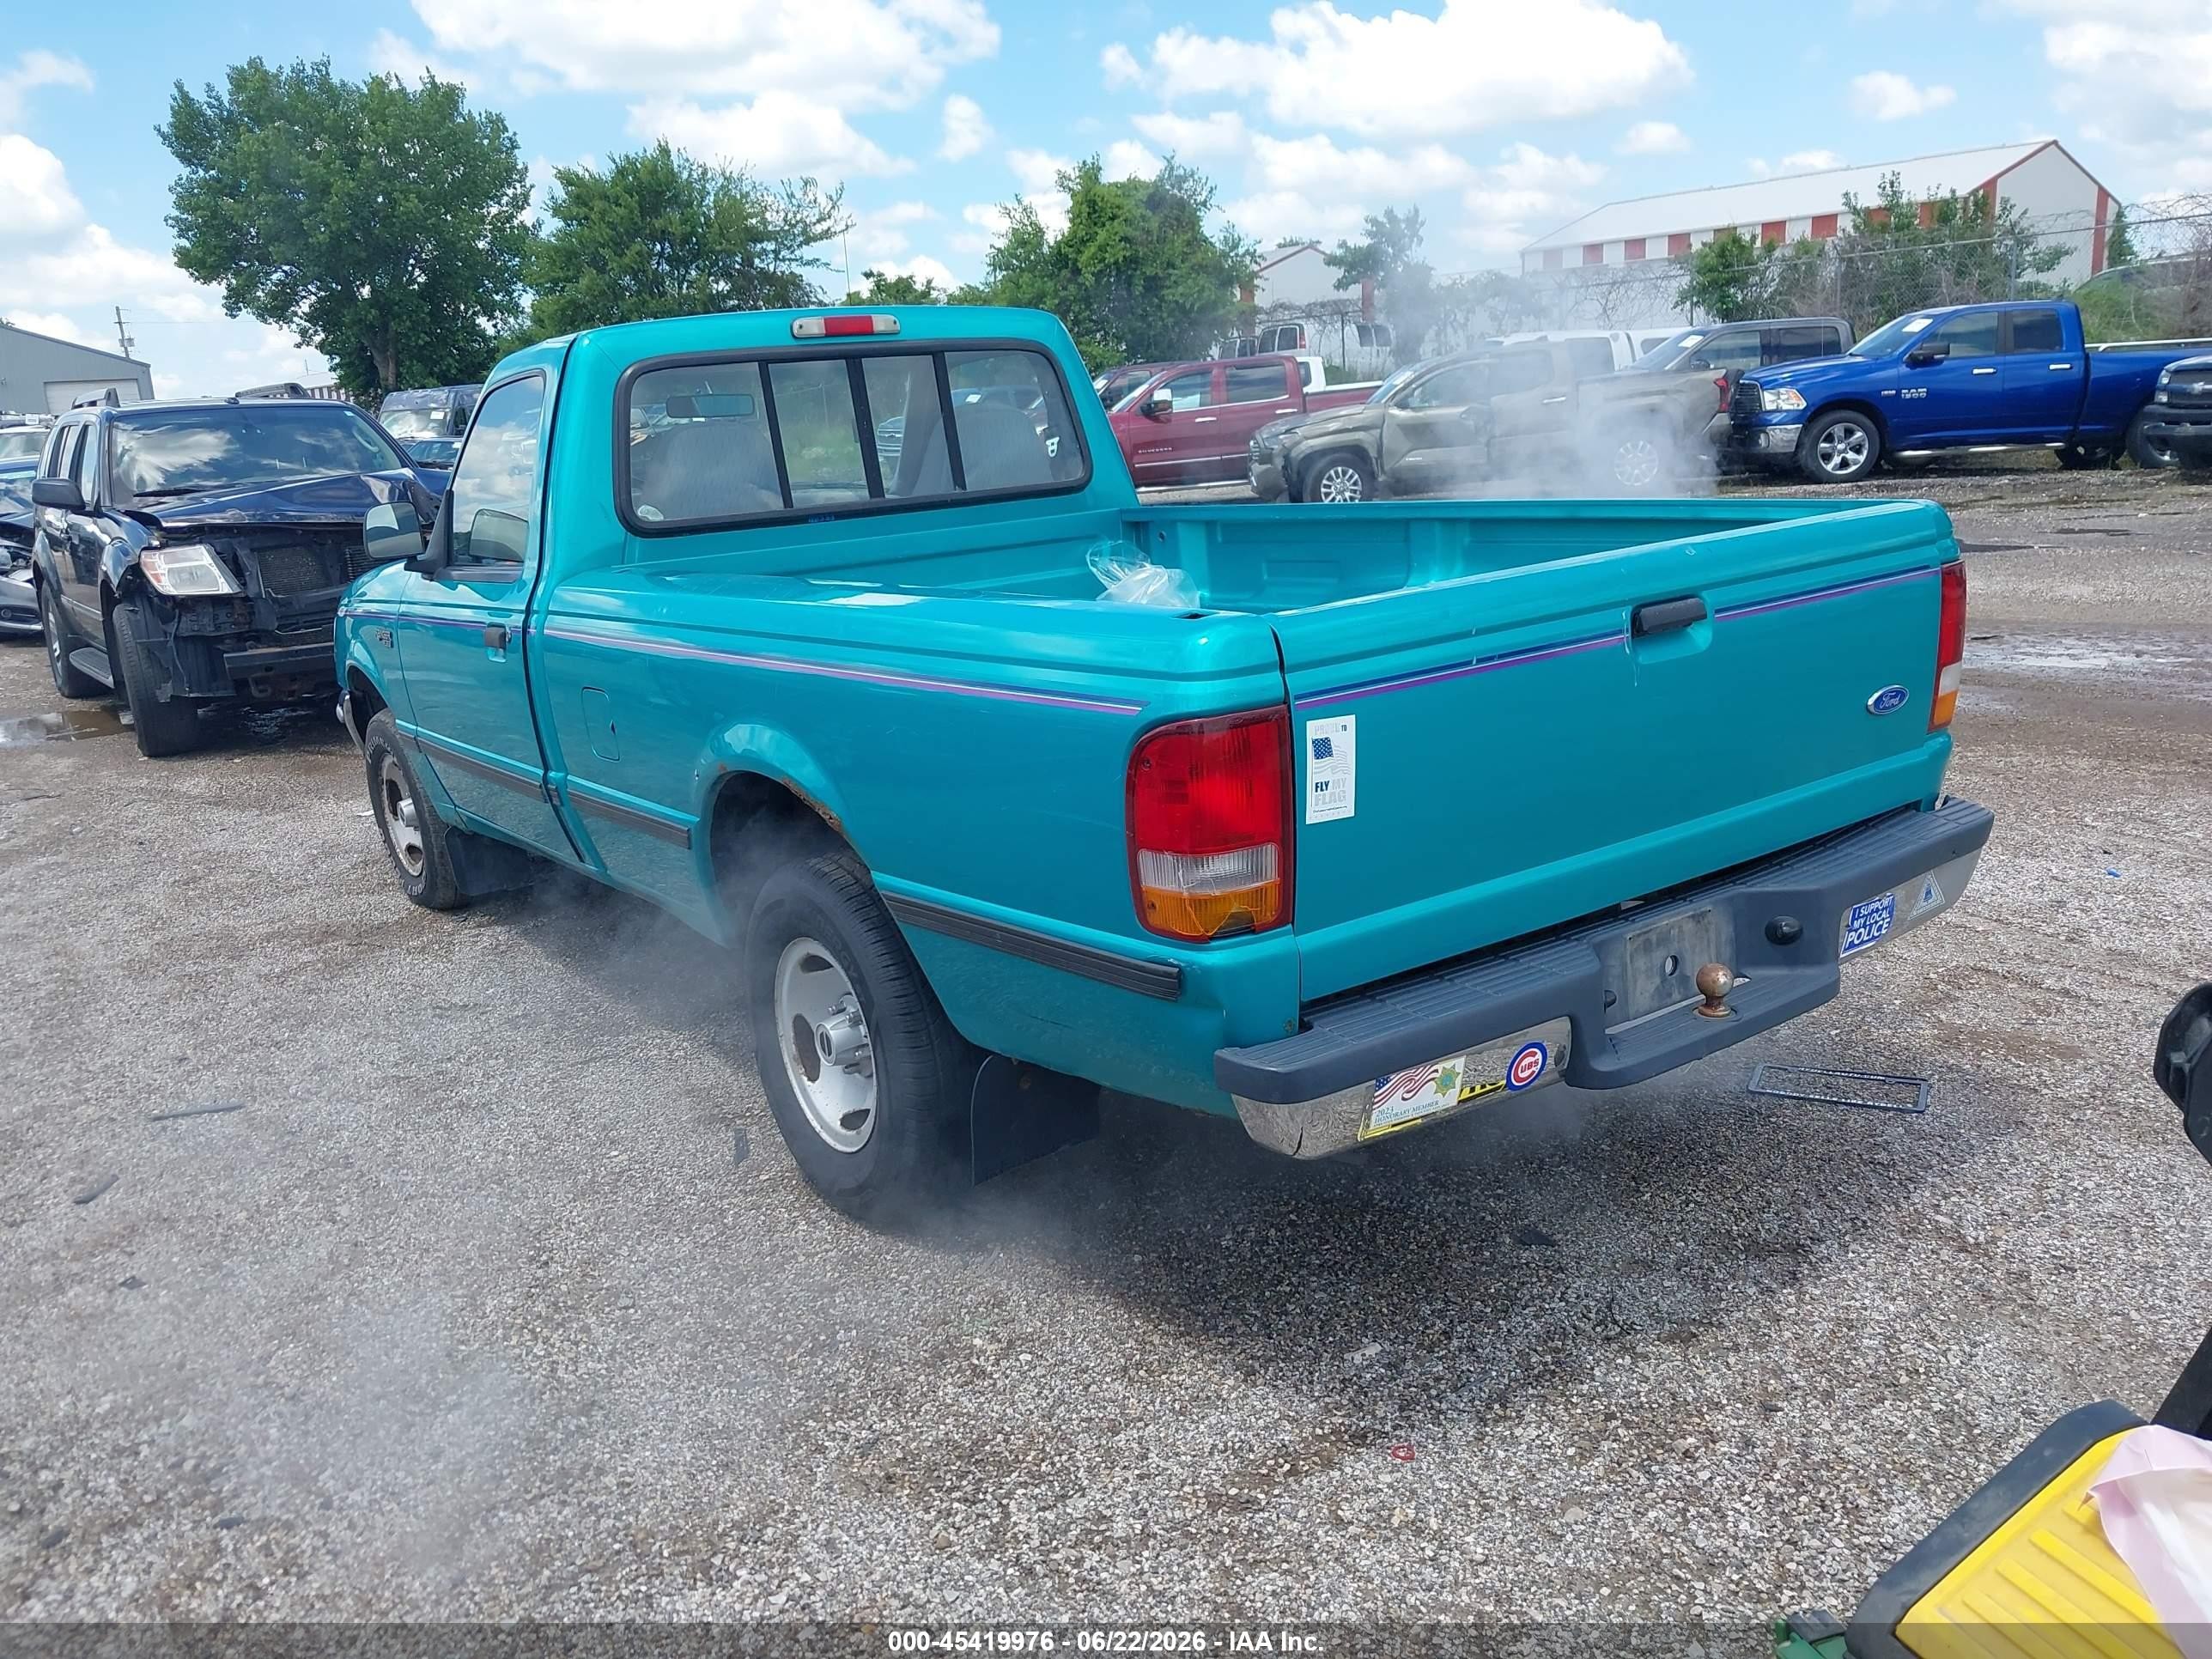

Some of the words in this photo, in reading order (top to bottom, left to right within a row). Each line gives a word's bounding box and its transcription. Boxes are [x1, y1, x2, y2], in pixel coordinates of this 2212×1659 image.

[1315, 780, 1329, 793] FLY
[1333, 777, 1346, 790] MY
[1314, 790, 1346, 806] FLAG
[1854, 917, 1866, 928] MY
[1866, 908, 1890, 926] LOCAL
[1856, 908, 1859, 919] I
[1859, 896, 1893, 916] SUPPORT
[1845, 918, 1890, 949] POLICE
[1374, 1109, 1412, 1123] HONORARY
[1412, 1100, 1439, 1112] MEMBER
